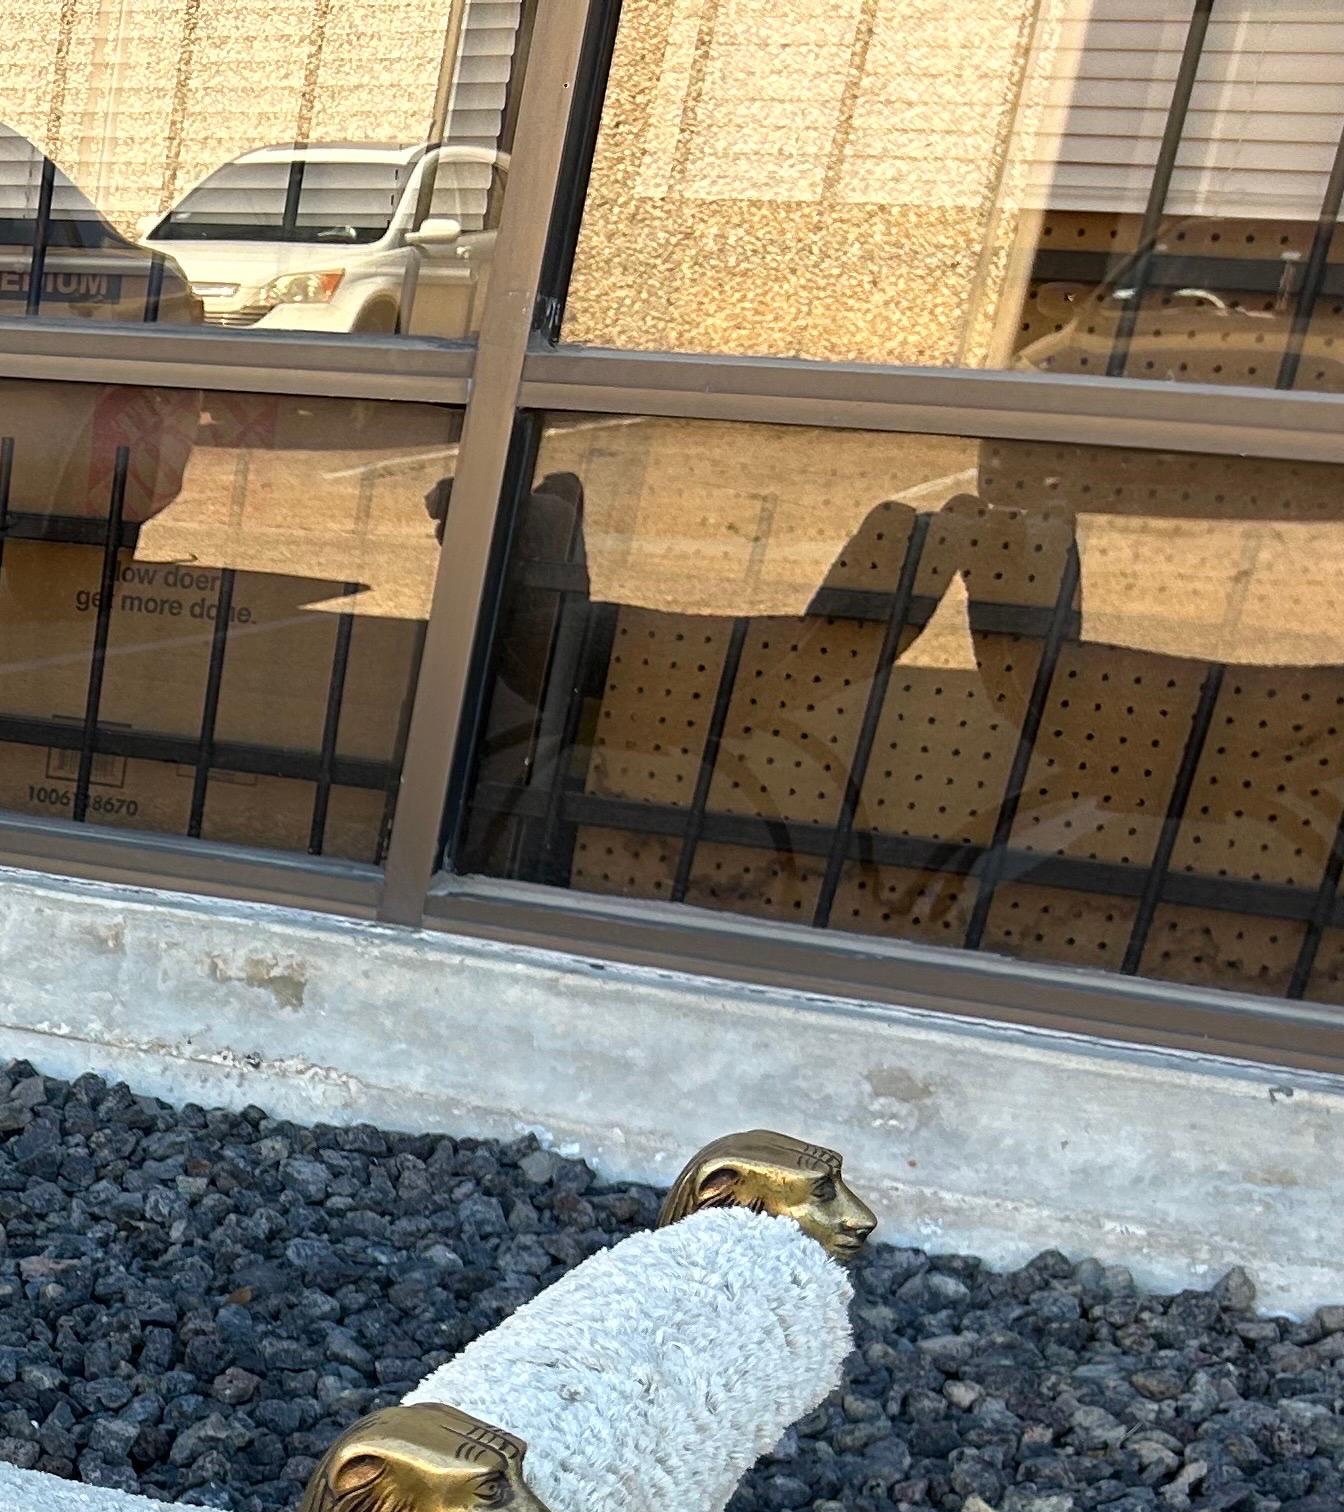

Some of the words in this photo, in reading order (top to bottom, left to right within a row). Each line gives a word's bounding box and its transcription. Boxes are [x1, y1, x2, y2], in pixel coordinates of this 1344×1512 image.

[163, 566, 221, 592] doer
[75, 587, 115, 612] ge
[121, 594, 183, 617] more
[28, 784, 140, 817] 10068670
